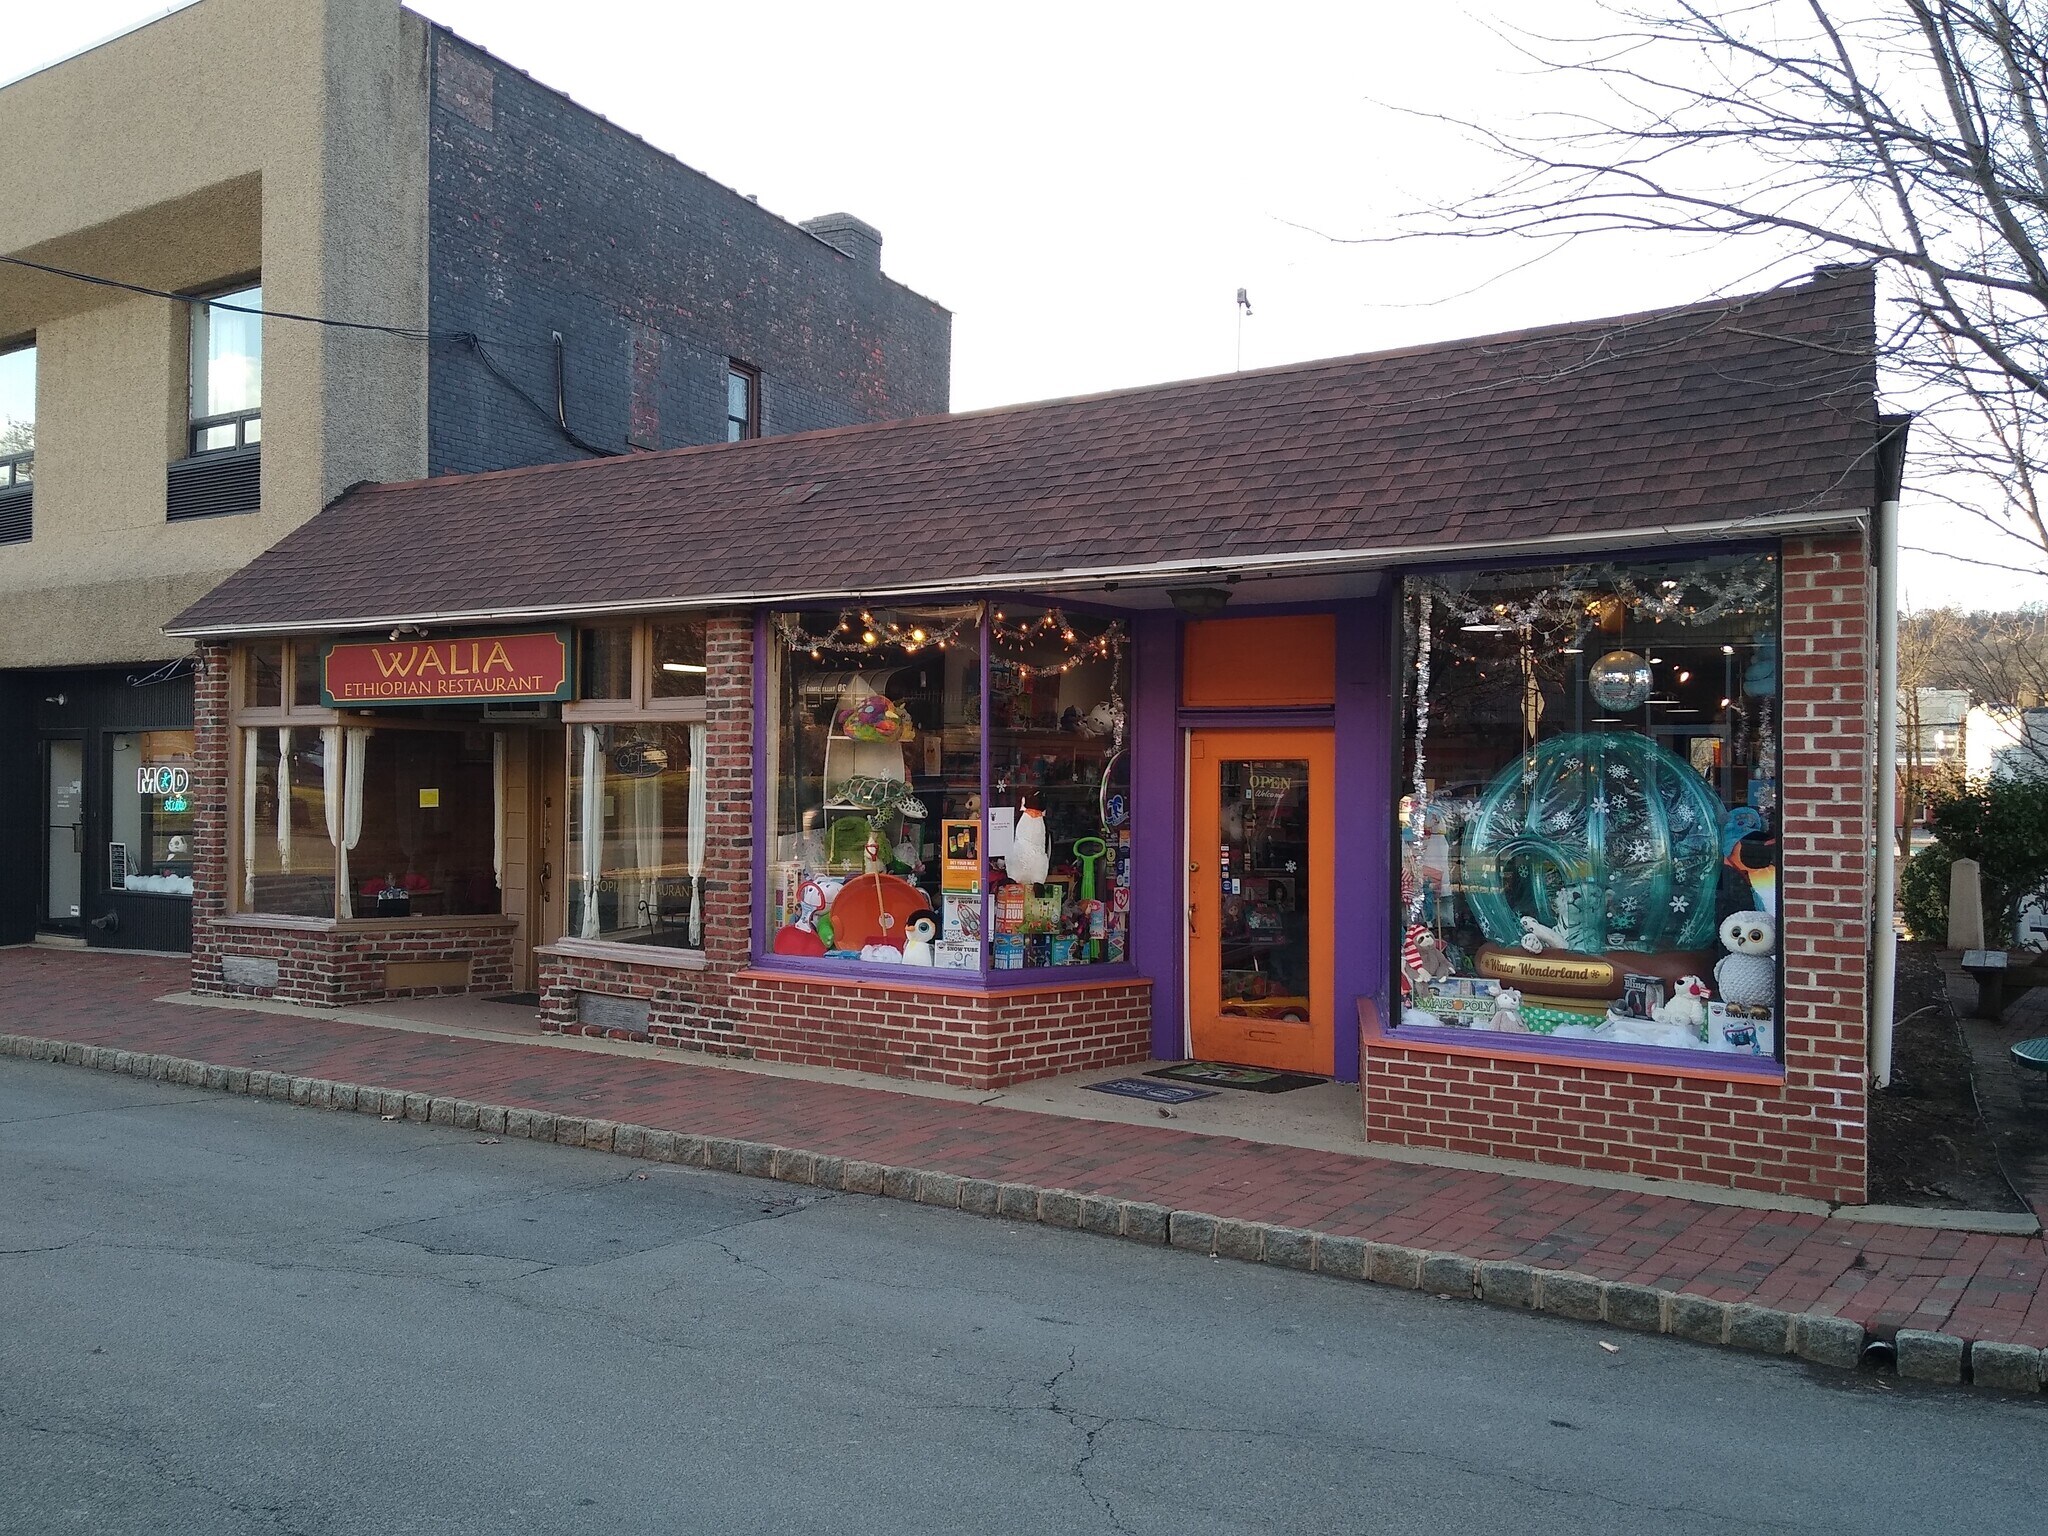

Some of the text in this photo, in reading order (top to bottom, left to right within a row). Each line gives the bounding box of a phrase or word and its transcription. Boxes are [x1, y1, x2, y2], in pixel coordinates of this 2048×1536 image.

[371, 642, 514, 678] WALIA
[344, 676, 543, 697] ETHIOPIAN RESTAURANT
[137, 766, 189, 794] MOD
[1249, 775, 1292, 790] OPEN
[1254, 789, 1285, 799] Welcome
[1005, 909, 1024, 919] RUN
[1490, 957, 1589, 980] Winter Wonderland
